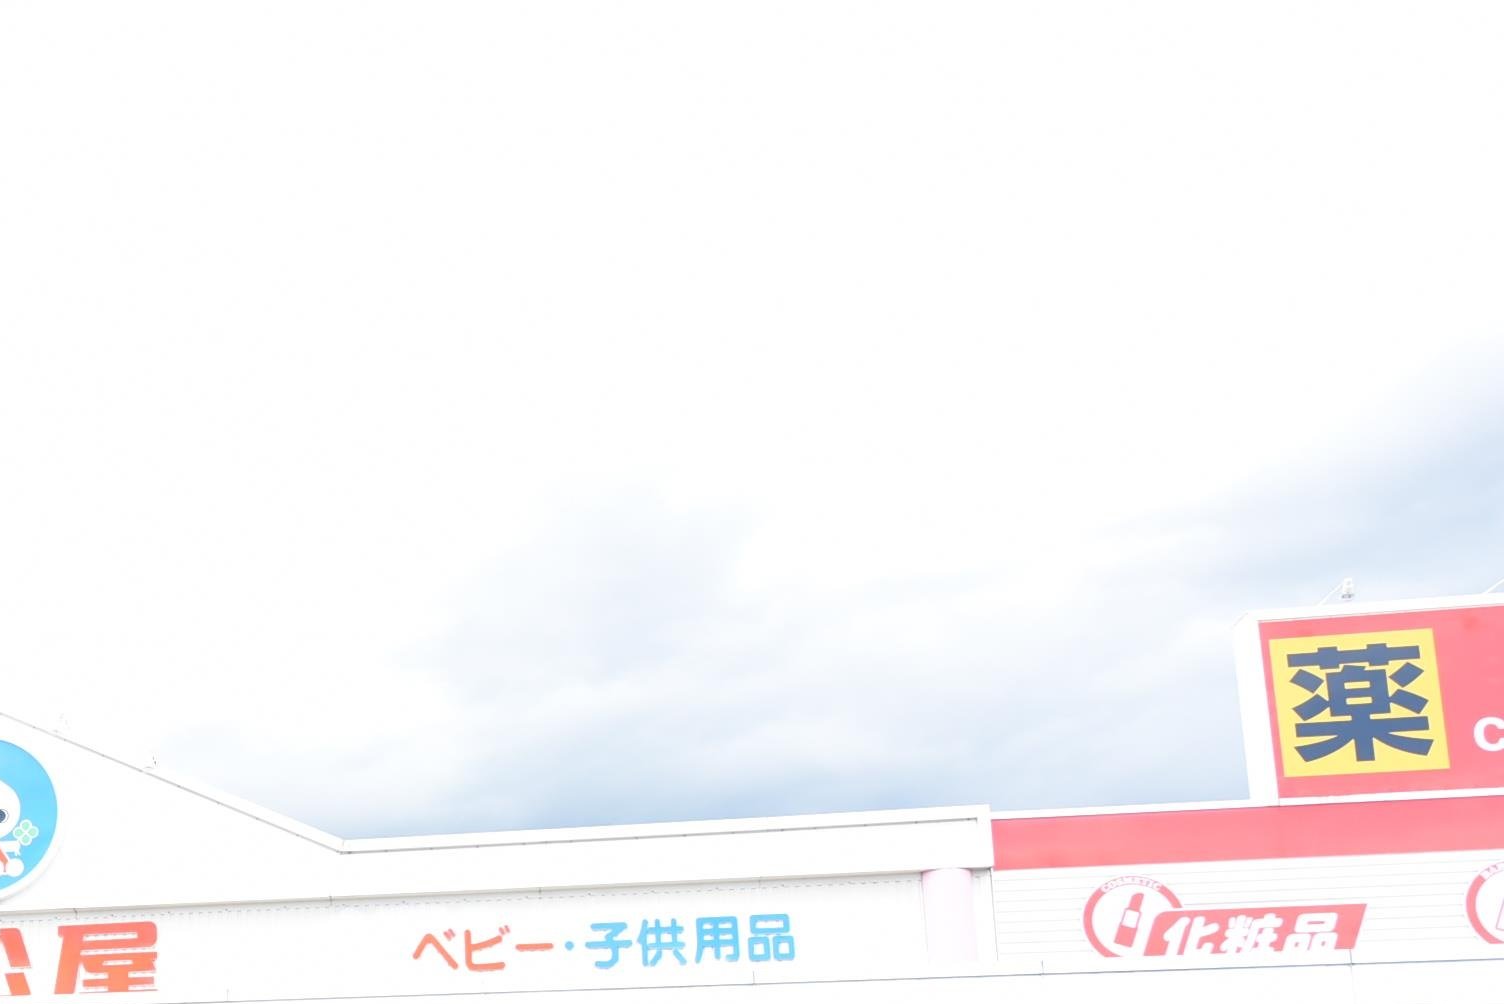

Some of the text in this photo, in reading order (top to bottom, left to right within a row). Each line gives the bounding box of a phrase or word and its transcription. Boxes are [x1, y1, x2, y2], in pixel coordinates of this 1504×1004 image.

[1286, 643, 1434, 762] 薬
[1163, 911, 1339, 956] 化粧品
